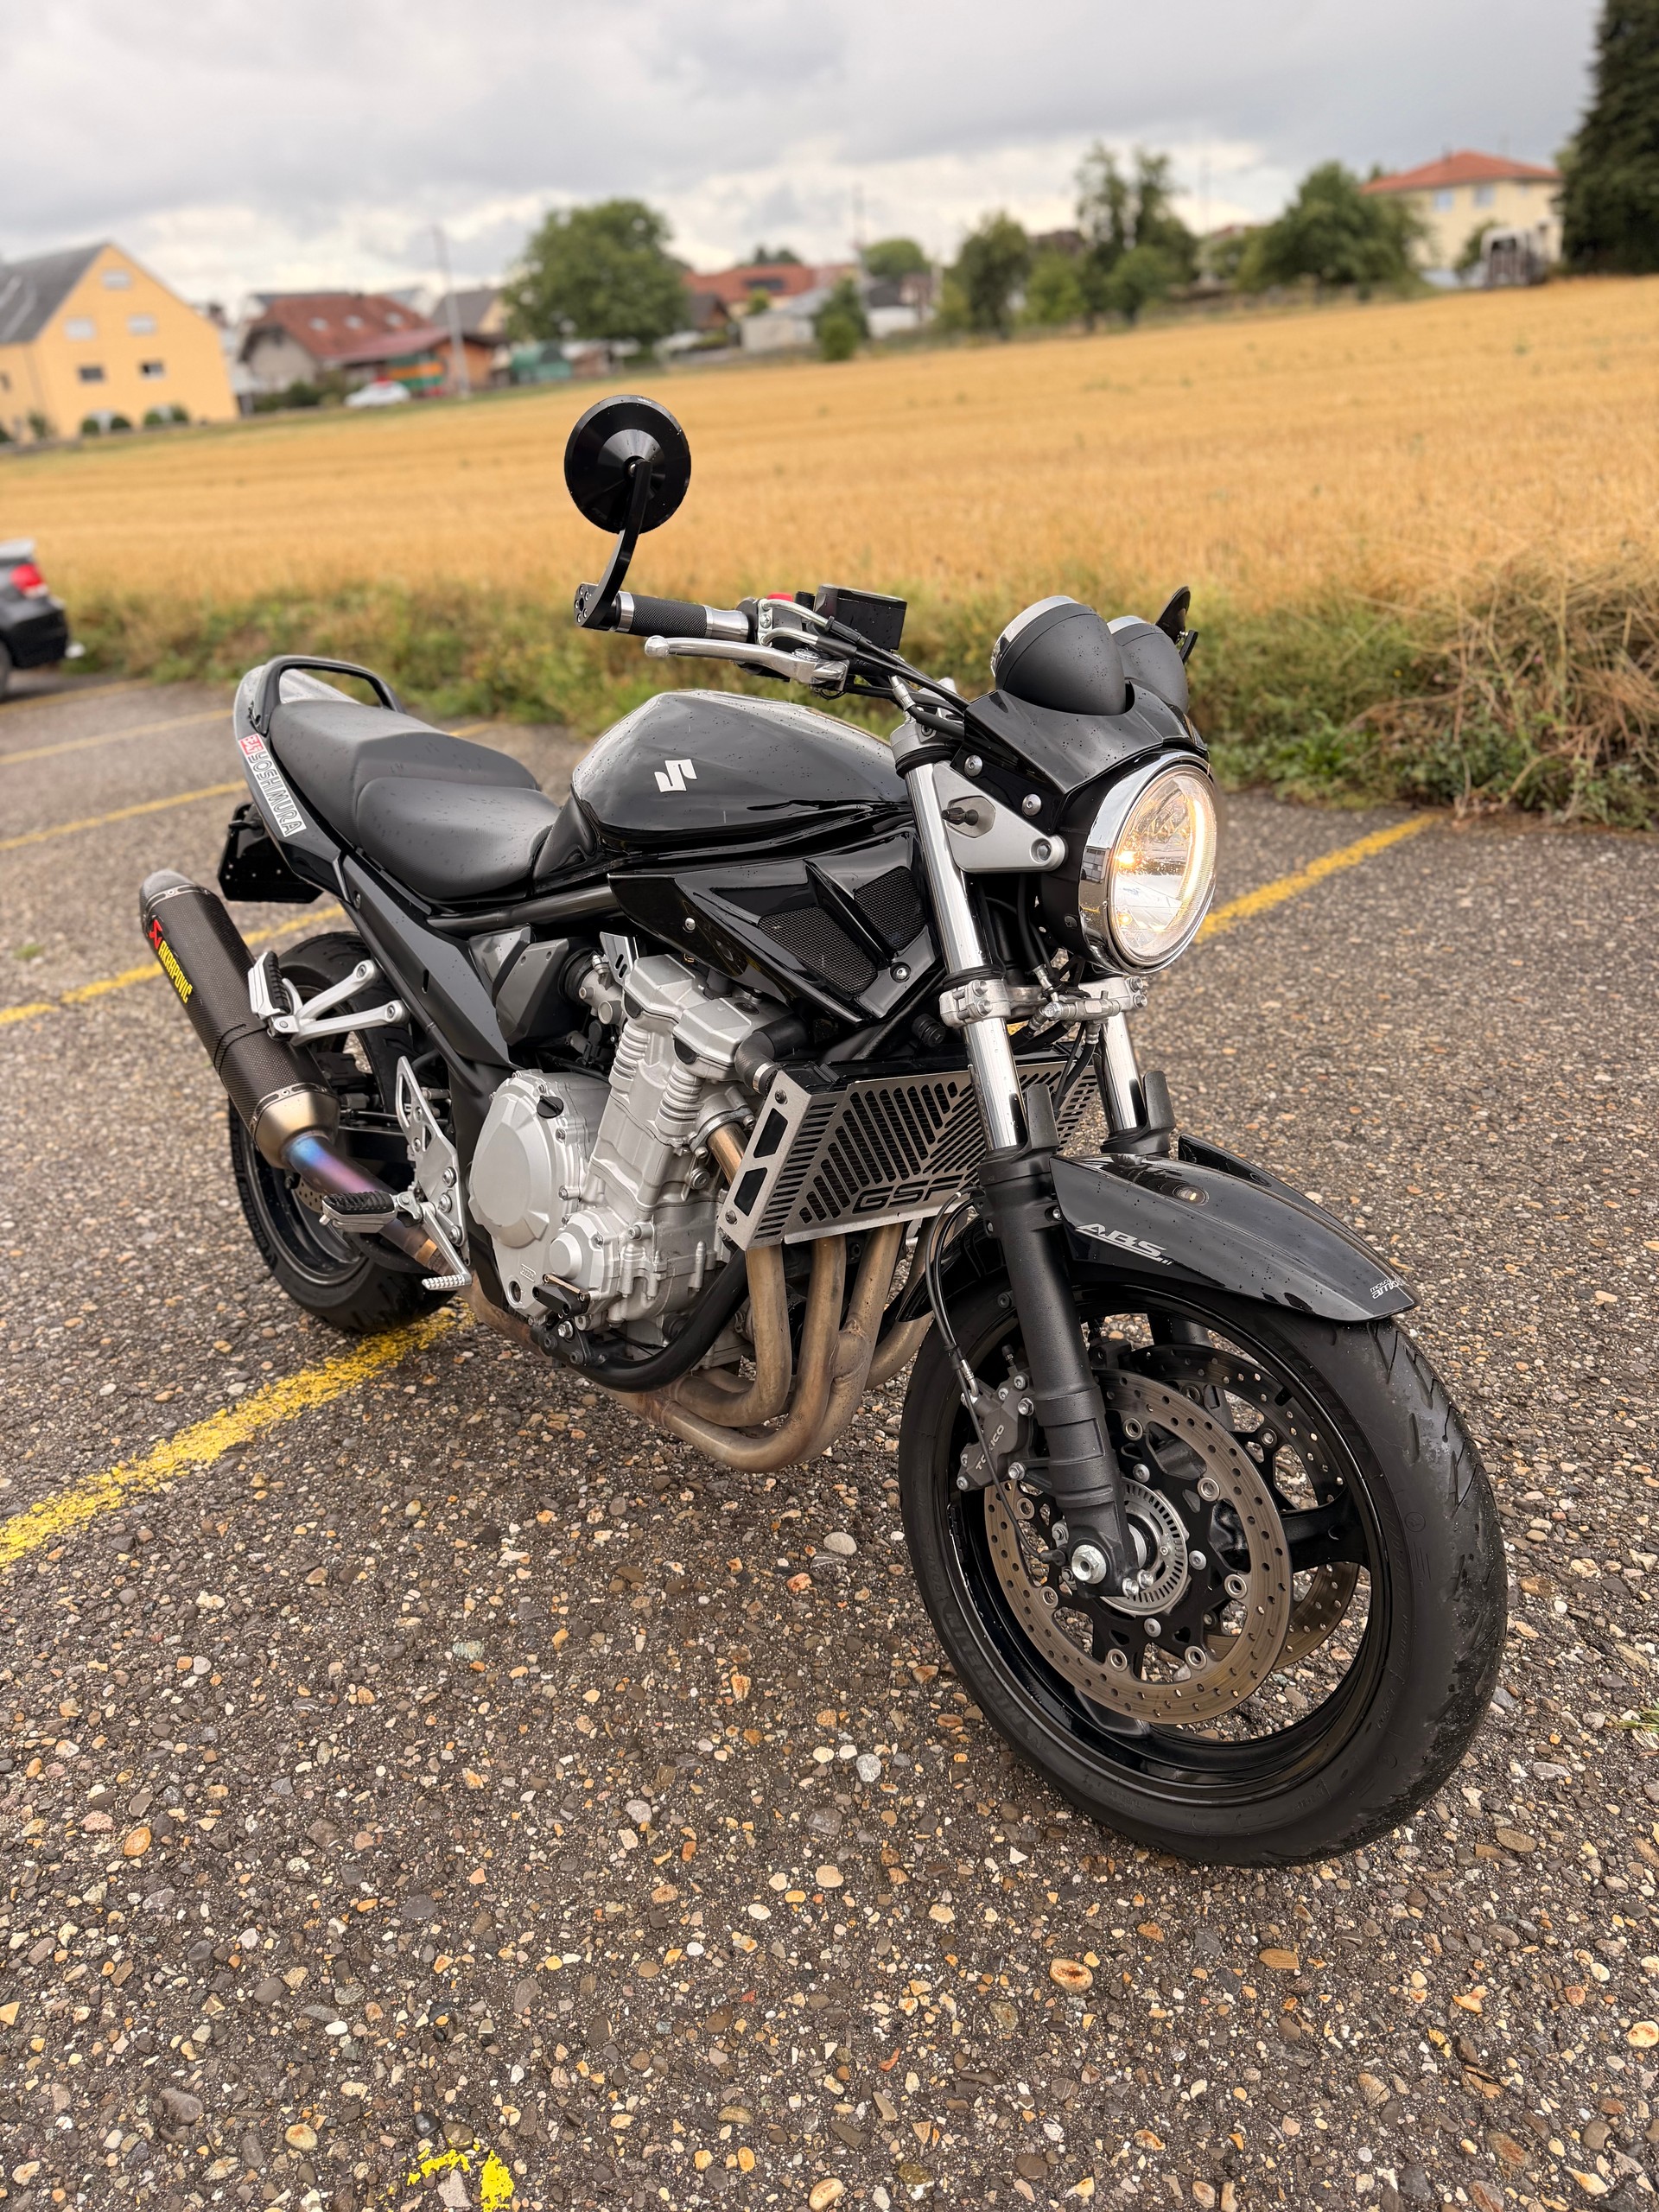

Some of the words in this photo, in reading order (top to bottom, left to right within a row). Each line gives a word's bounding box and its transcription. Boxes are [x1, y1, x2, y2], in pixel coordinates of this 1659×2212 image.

[248, 751, 303, 836] YOSHIMURA
[238, 1182, 269, 1249] MICHELIN
[851, 1173, 964, 1215] GSF
[1076, 1223, 1167, 1259] ABS
[975, 1424, 1005, 1471] TOICO
[944, 1611, 1026, 1726] MICHELIN
